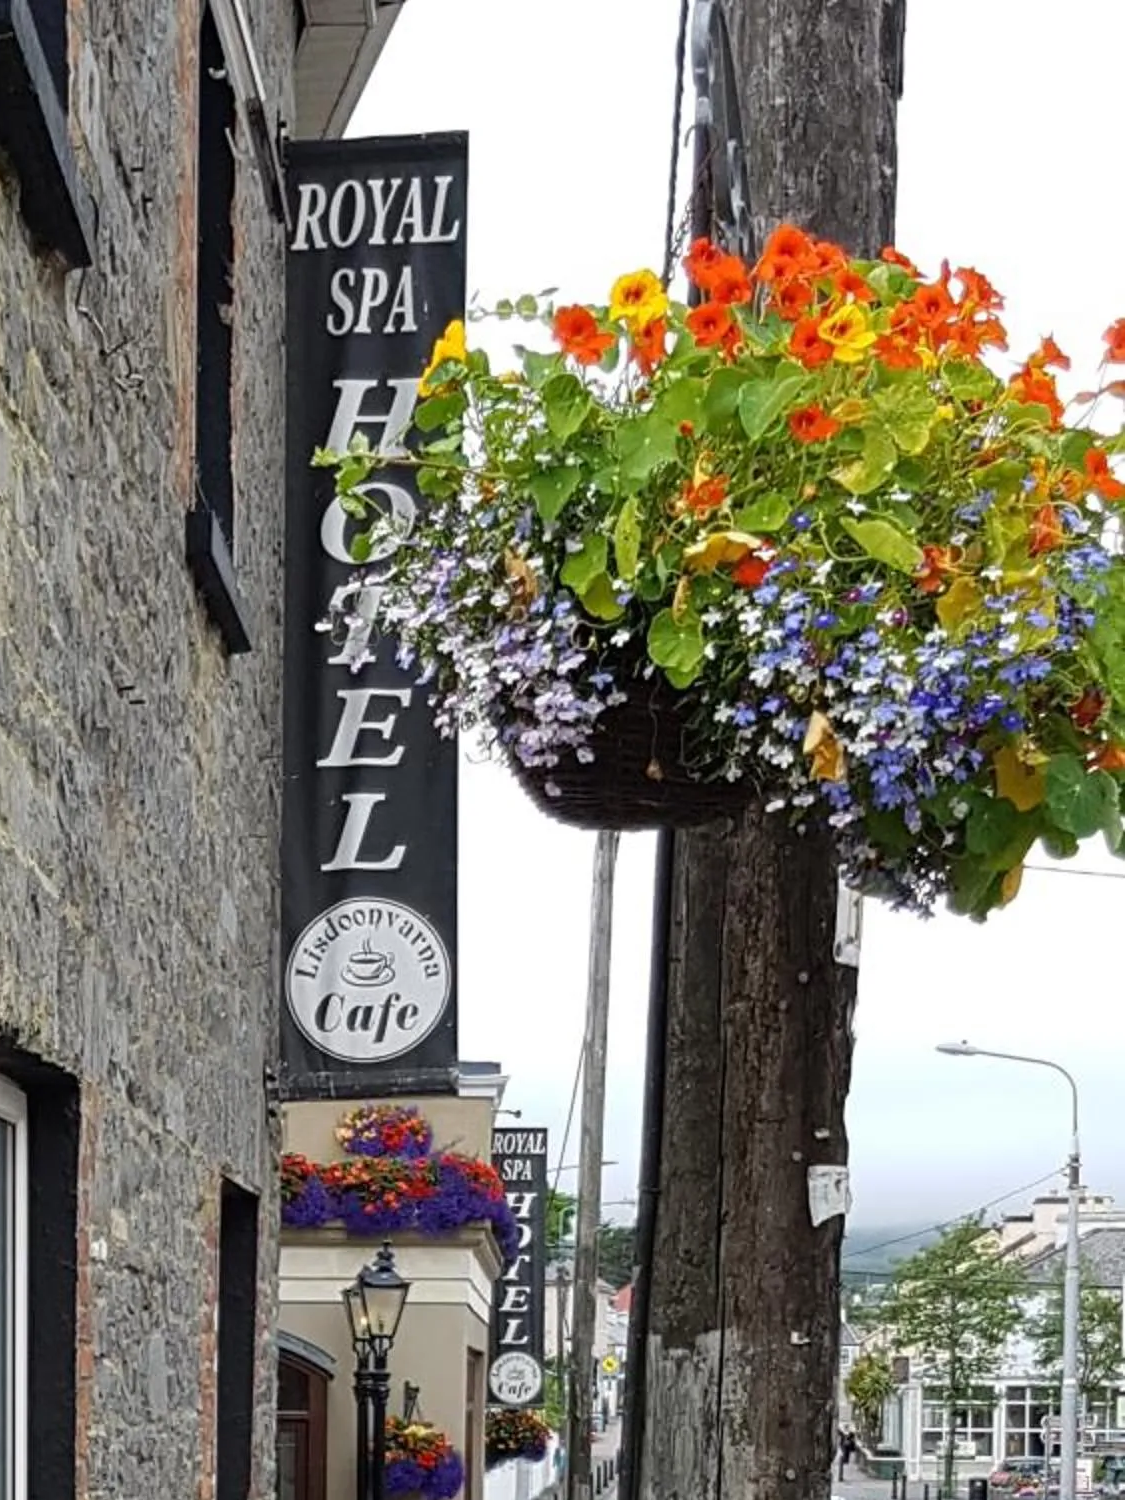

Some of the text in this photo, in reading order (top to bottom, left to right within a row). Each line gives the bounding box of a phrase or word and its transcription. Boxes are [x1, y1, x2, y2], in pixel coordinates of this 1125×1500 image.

[290, 174, 460, 251] ROYAL
[326, 264, 418, 336] SPA
[314, 991, 420, 1044] Cafe
[492, 1132, 546, 1155] ROYAL
[502, 1159, 533, 1181] SPA
